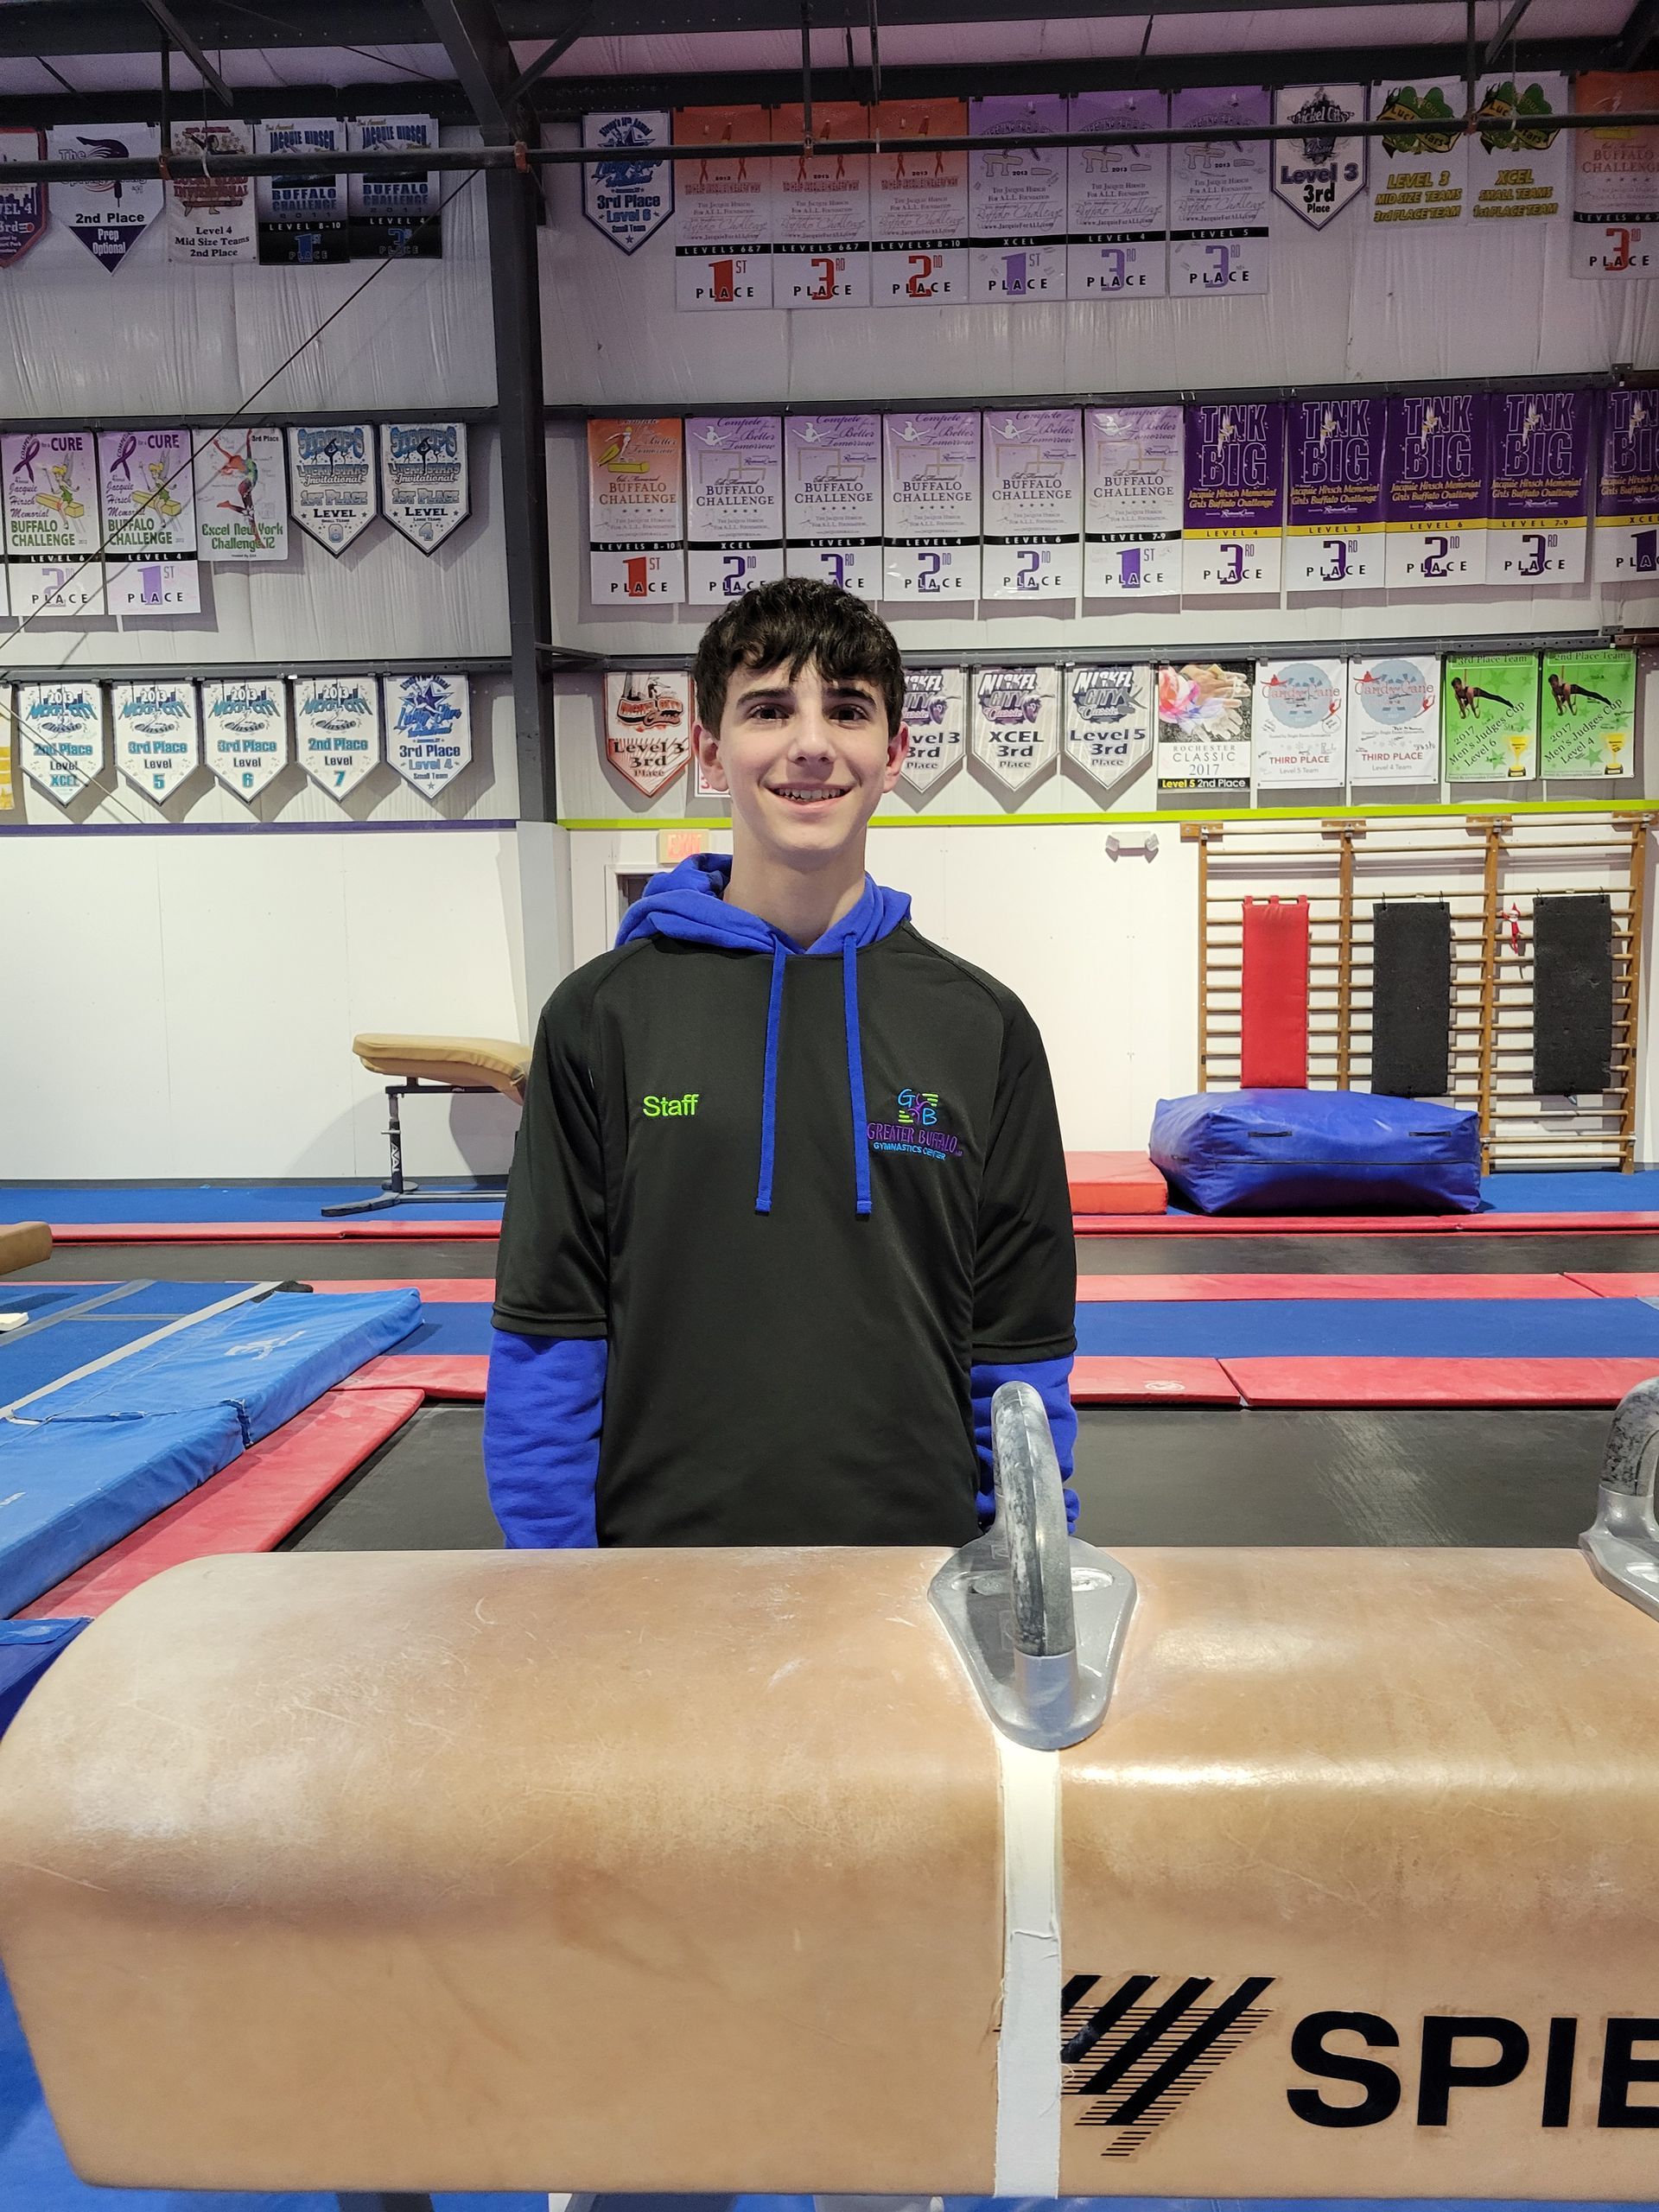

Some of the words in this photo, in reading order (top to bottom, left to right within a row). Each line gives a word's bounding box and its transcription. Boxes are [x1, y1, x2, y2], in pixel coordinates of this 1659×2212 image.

[1593, 149, 1654, 161] BUFFALO
[1281, 162, 1338, 184] Level
[1344, 162, 1359, 181] 3
[1495, 169, 1534, 185] XCEL
[1387, 172, 1433, 189] LEVEL
[1438, 170, 1451, 187] 3
[272, 188, 336, 200] BUFFALO
[364, 183, 428, 194] BUFFALO
[1303, 181, 1336, 203] 3rd
[597, 195, 620, 209] 3rd
[625, 195, 660, 208] Place
[1306, 203, 1330, 213] Place
[76, 214, 101, 224] 2nd
[107, 213, 145, 223] Place
[98, 229, 119, 241] Prep
[196, 226, 222, 235] Level
[175, 236, 195, 245] Mid
[198, 237, 218, 245] Size
[221, 236, 250, 245] Teams
[92, 243, 126, 256] Optional
[190, 249, 207, 257] 2nd
[210, 248, 238, 257] Place
[782, 244, 832, 252] LEVELS
[838, 243, 860, 251] 6&7
[1589, 255, 1650, 267] PLACE
[1087, 275, 1147, 288] PLACE
[1190, 270, 1249, 283] PLACE
[793, 284, 851, 296] PLACE
[893, 282, 950, 295] PLACE
[988, 278, 1048, 290] PLACE
[696, 287, 753, 298] PLACE
[1403, 395, 1473, 435] TINK
[1506, 391, 1574, 433] TINK
[1201, 404, 1268, 443] TINK
[1302, 399, 1370, 440] TINK
[52, 436, 83, 451] CURE
[147, 434, 181, 449] CURE
[1303, 437, 1370, 484] BIG
[1404, 433, 1471, 480] BIG
[1503, 431, 1573, 478] BIG
[1201, 442, 1268, 487] BIG
[1003, 479, 1062, 490] BUFFALO
[1105, 475, 1164, 486] BUFFALO
[609, 483, 666, 493] BUFFALO
[706, 485, 765, 495] BUFFALO
[804, 483, 863, 493] BUFFALO
[903, 482, 962, 492] BUFFALO
[1093, 486, 1174, 499] CHALLENGE
[599, 493, 677, 505] CHALLENGE
[696, 496, 774, 506] CHALLENGE
[795, 493, 874, 504] CHALLENGE
[893, 492, 972, 503] CHALLENGE
[993, 490, 1071, 501] CHALLENGE
[314, 508, 356, 518] LEVEL
[405, 506, 448, 517] LEVEL
[11, 519, 58, 533] BUFFALO
[108, 518, 155, 532] BUFFALO
[1503, 519, 1546, 528] LEVEL
[1554, 518, 1569, 527] 7-9
[201, 523, 231, 537] Excel
[234, 522, 257, 535] New
[257, 522, 283, 536] York
[11, 533, 75, 547] CHALLENGE
[109, 532, 174, 546] CHALLENGE
[906, 538, 947, 547] LEVEL
[1102, 534, 1143, 543] LEVEL
[599, 543, 645, 551] LEVELS
[653, 542, 677, 550] 8-10
[721, 542, 752, 550] XCEL
[128, 553, 168, 562] LEVEL
[1306, 564, 1365, 577] PLACE
[1407, 561, 1468, 574] PLACE
[1504, 558, 1566, 571] PLACE
[1003, 575, 1061, 587] PLACE
[1105, 573, 1164, 584] PLACE
[1204, 569, 1262, 581] PLACE
[611, 582, 668, 593] PLACE
[904, 578, 963, 588] PLACE
[32, 594, 88, 604] PLACE
[128, 592, 184, 603] PLACE
[1457, 657, 1475, 665] 3rd
[1477, 656, 1502, 664] Place
[1503, 654, 1529, 663] Team
[1574, 652, 1599, 661] Place
[1600, 651, 1627, 660] Team
[978, 673, 1038, 696] NICKEL
[1073, 670, 1134, 695] NICKEL
[988, 731, 1045, 743] XCEL
[1070, 728, 1129, 741] Level
[1134, 728, 1146, 741] 5
[1453, 726, 1476, 746] 2017
[1549, 722, 1573, 743] 2017
[128, 741, 151, 754] 3rd
[153, 741, 188, 754] Place
[217, 740, 241, 753] 3rd
[242, 740, 277, 753] Place
[308, 738, 332, 752] 2nd
[333, 738, 369, 752] Place
[614, 741, 666, 754] Level
[671, 742, 685, 754] 3
[997, 745, 1033, 757] 3rd
[1090, 743, 1128, 755] 3rd
[399, 746, 423, 758] 3rd
[427, 745, 461, 758] Place
[1173, 753, 1236, 762] CLASSIC
[1361, 753, 1391, 762] THIRD
[1393, 751, 1423, 760] PLACE
[144, 759, 172, 769] Level
[233, 757, 262, 768] Level
[324, 756, 353, 766] Level
[409, 759, 442, 771] Level
[443, 758, 454, 770] 4
[630, 755, 667, 768] 3rd
[906, 761, 938, 771] Place
[999, 760, 1032, 769] Place
[1268, 756, 1298, 766] THIRD
[1300, 756, 1330, 765] PLACE
[634, 769, 664, 778] Place
[1189, 763, 1220, 776] 2017
[153, 773, 165, 790] 5
[242, 772, 254, 788] 6
[334, 770, 346, 787] 7
[1162, 779, 1188, 790] Level
[1189, 779, 1196, 789] 5
[1197, 779, 1217, 789] 2nd
[1217, 779, 1246, 789] Place
[898, 1088, 916, 1109] G
[643, 1094, 700, 1117] Staff
[922, 1107, 938, 1126] B
[867, 1122, 915, 1144] GREATER
[918, 1128, 958, 1154] BUFFALO
[873, 1141, 922, 1155] GYMNASTICS
[922, 1147, 947, 1161] CENTER
[1287, 2010, 1659, 2129] SPIE
